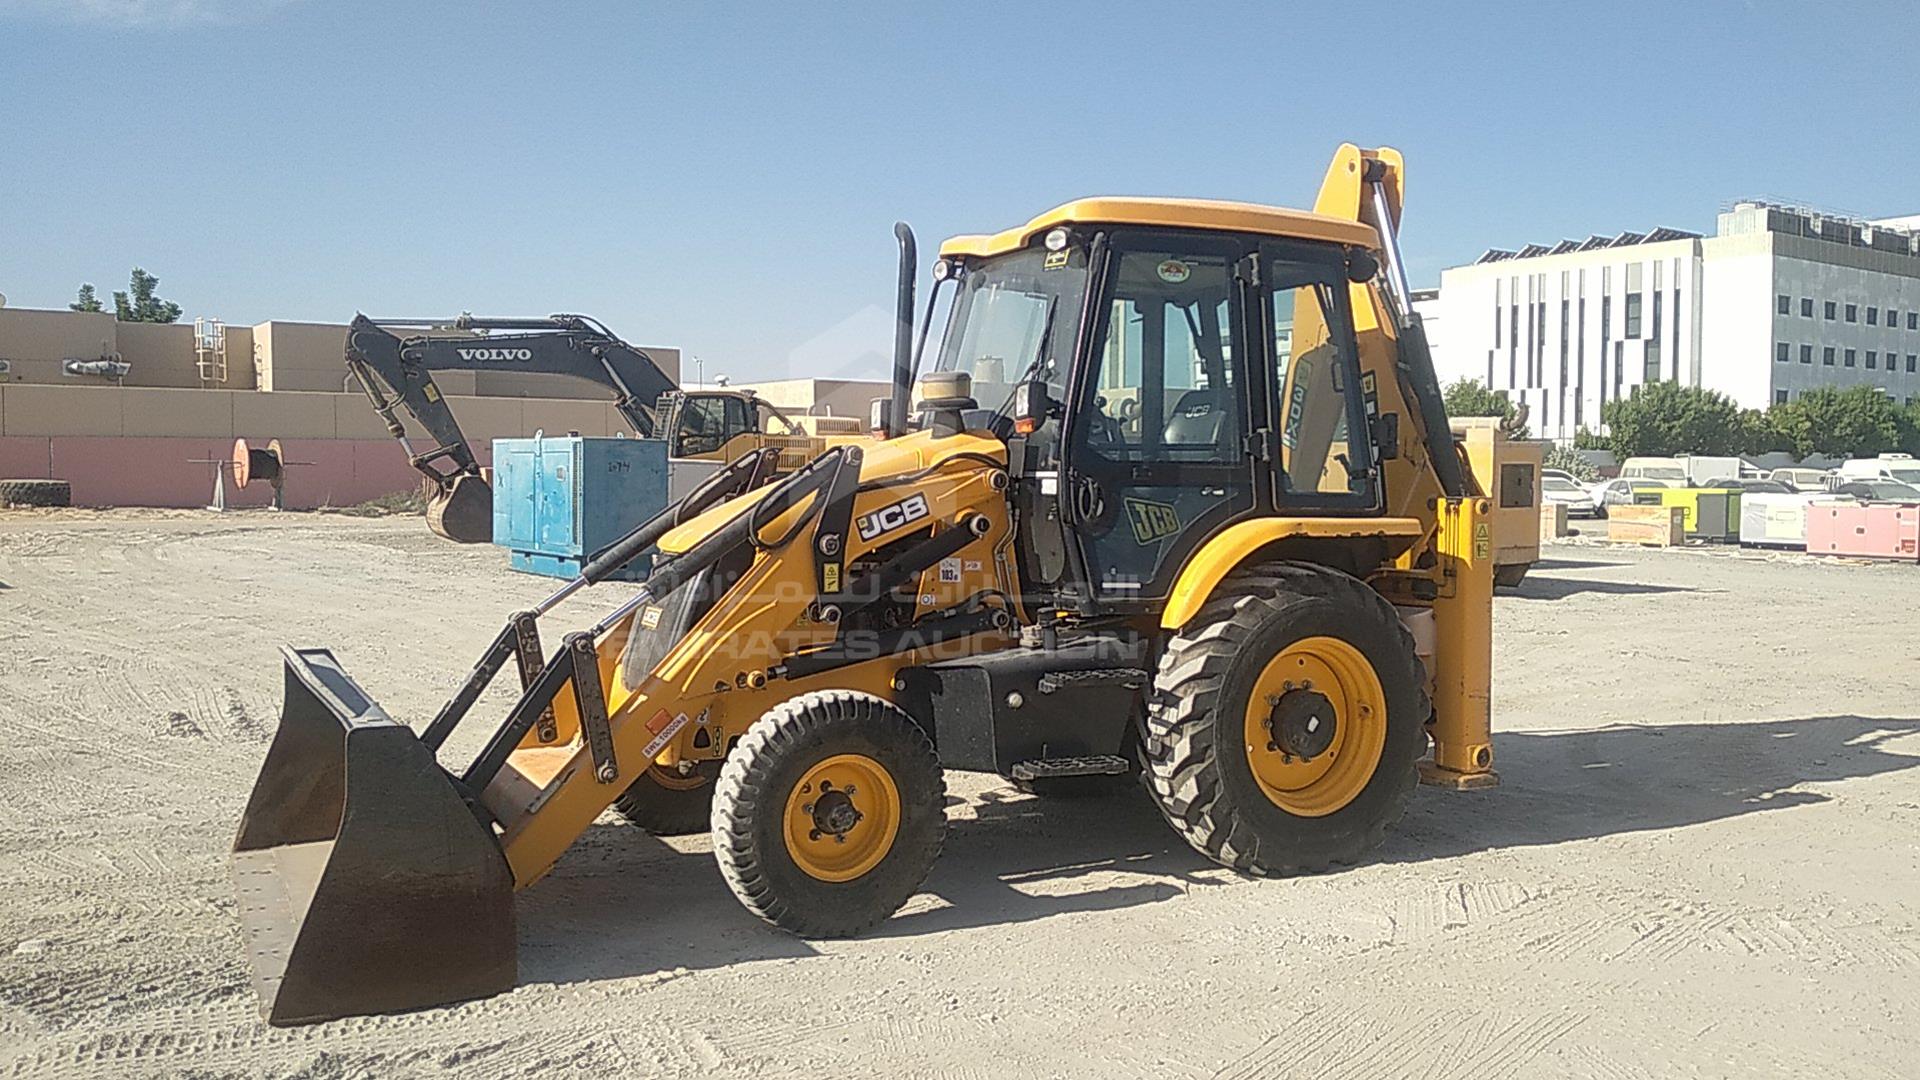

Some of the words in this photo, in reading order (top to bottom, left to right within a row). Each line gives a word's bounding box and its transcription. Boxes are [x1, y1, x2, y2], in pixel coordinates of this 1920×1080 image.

[456, 348, 532, 361] VOLVO
[1185, 404, 1210, 418] JCB
[858, 495, 928, 540] JCB
[1134, 502, 1178, 541] JCB
